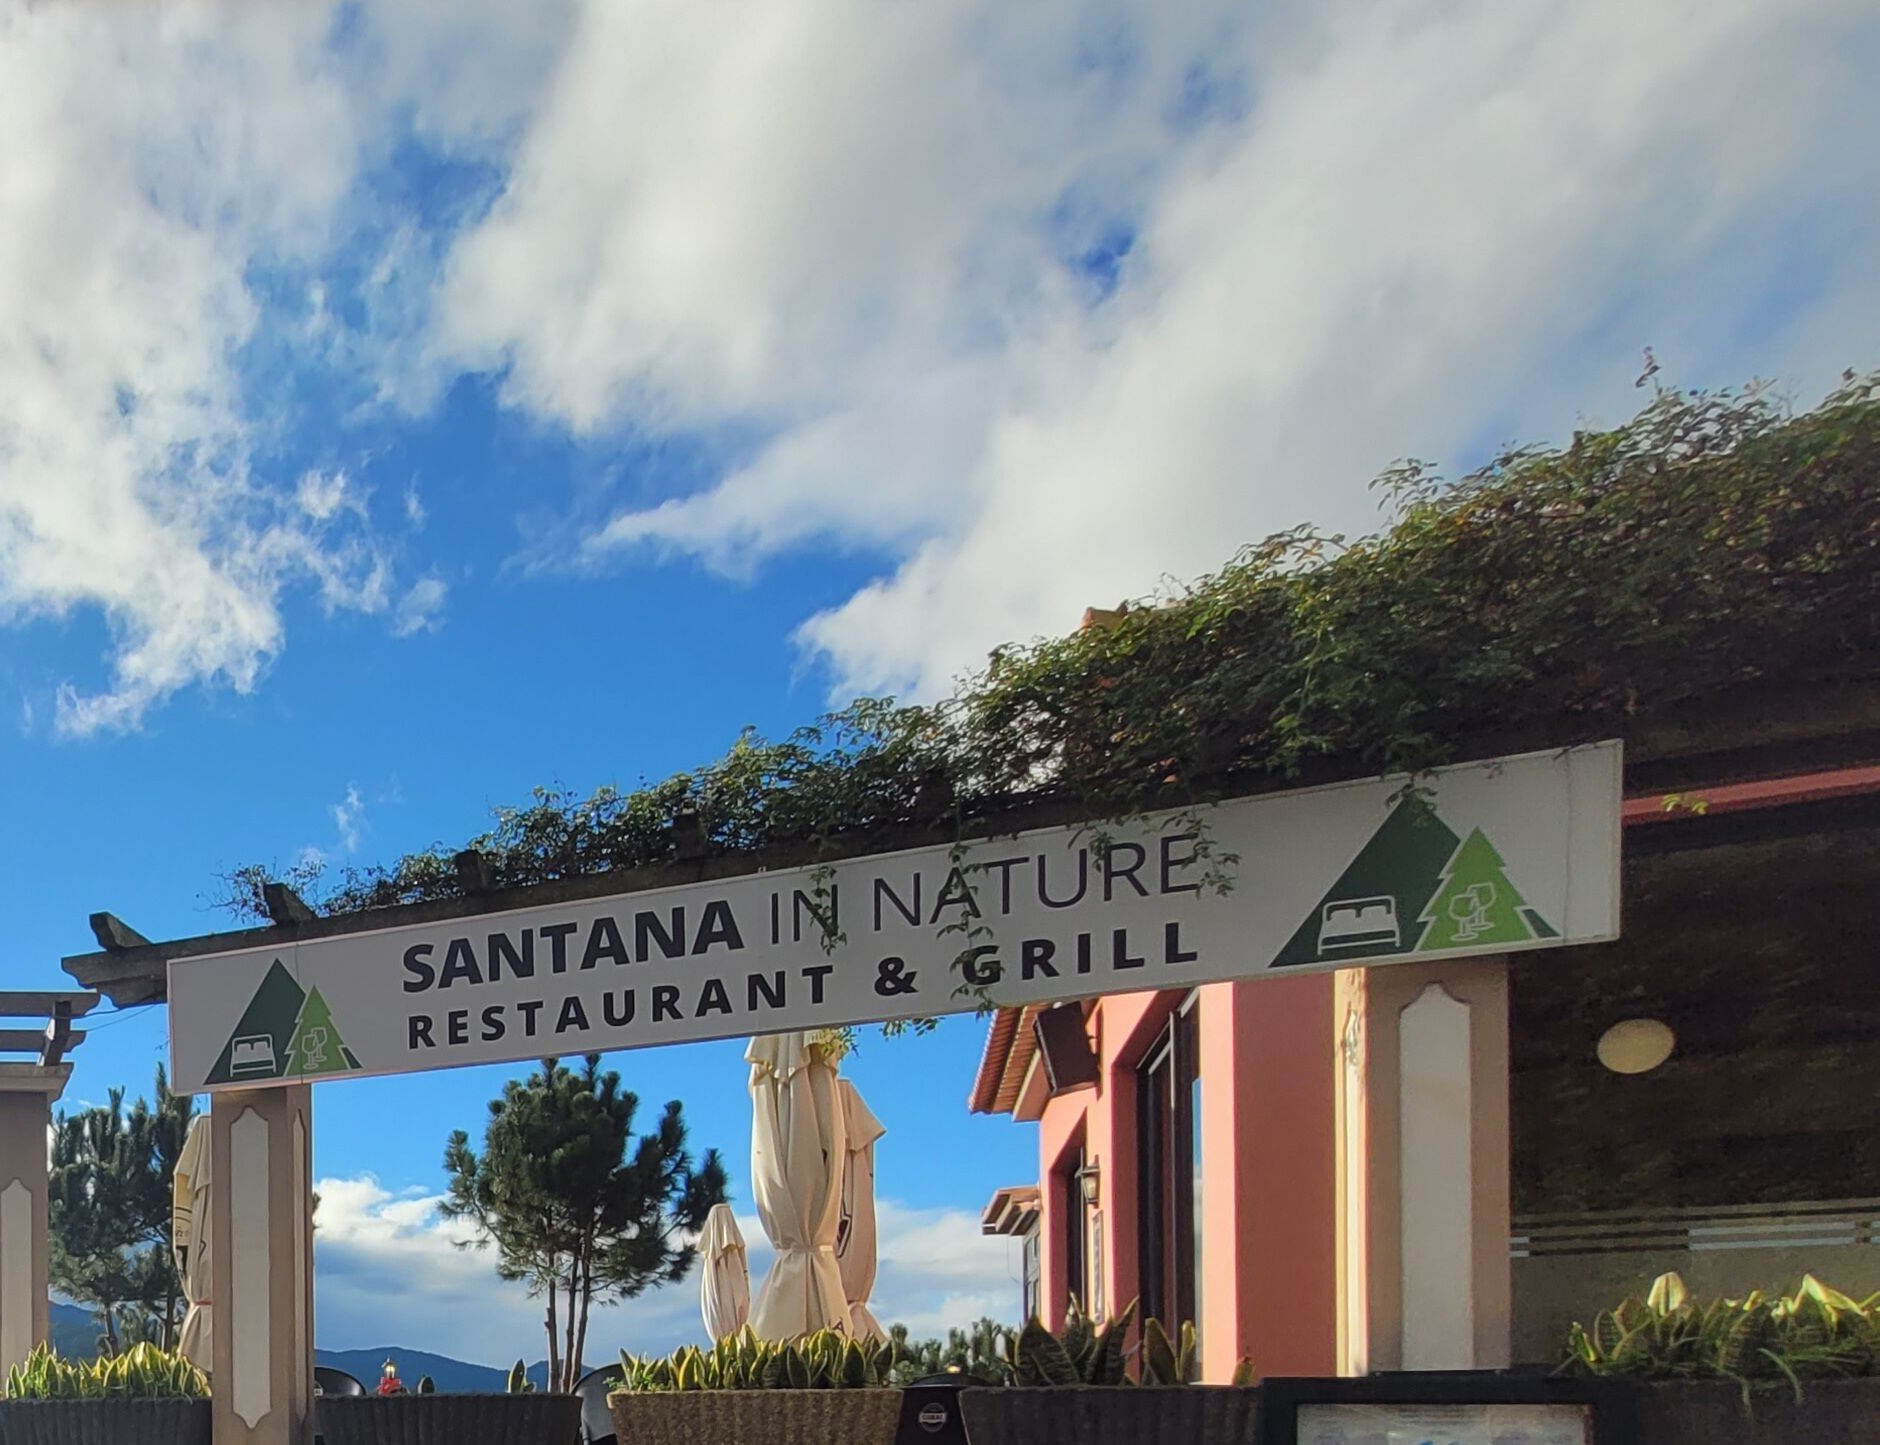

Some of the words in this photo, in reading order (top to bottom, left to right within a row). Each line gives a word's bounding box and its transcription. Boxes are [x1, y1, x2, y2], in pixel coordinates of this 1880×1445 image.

[403, 900, 744, 993] SANTANA
[770, 884, 838, 945] IN
[873, 833, 1199, 931] NATURE
[408, 965, 833, 1049] RESTAURANT
[873, 957, 919, 997] &
[961, 922, 1198, 986] GRILL
